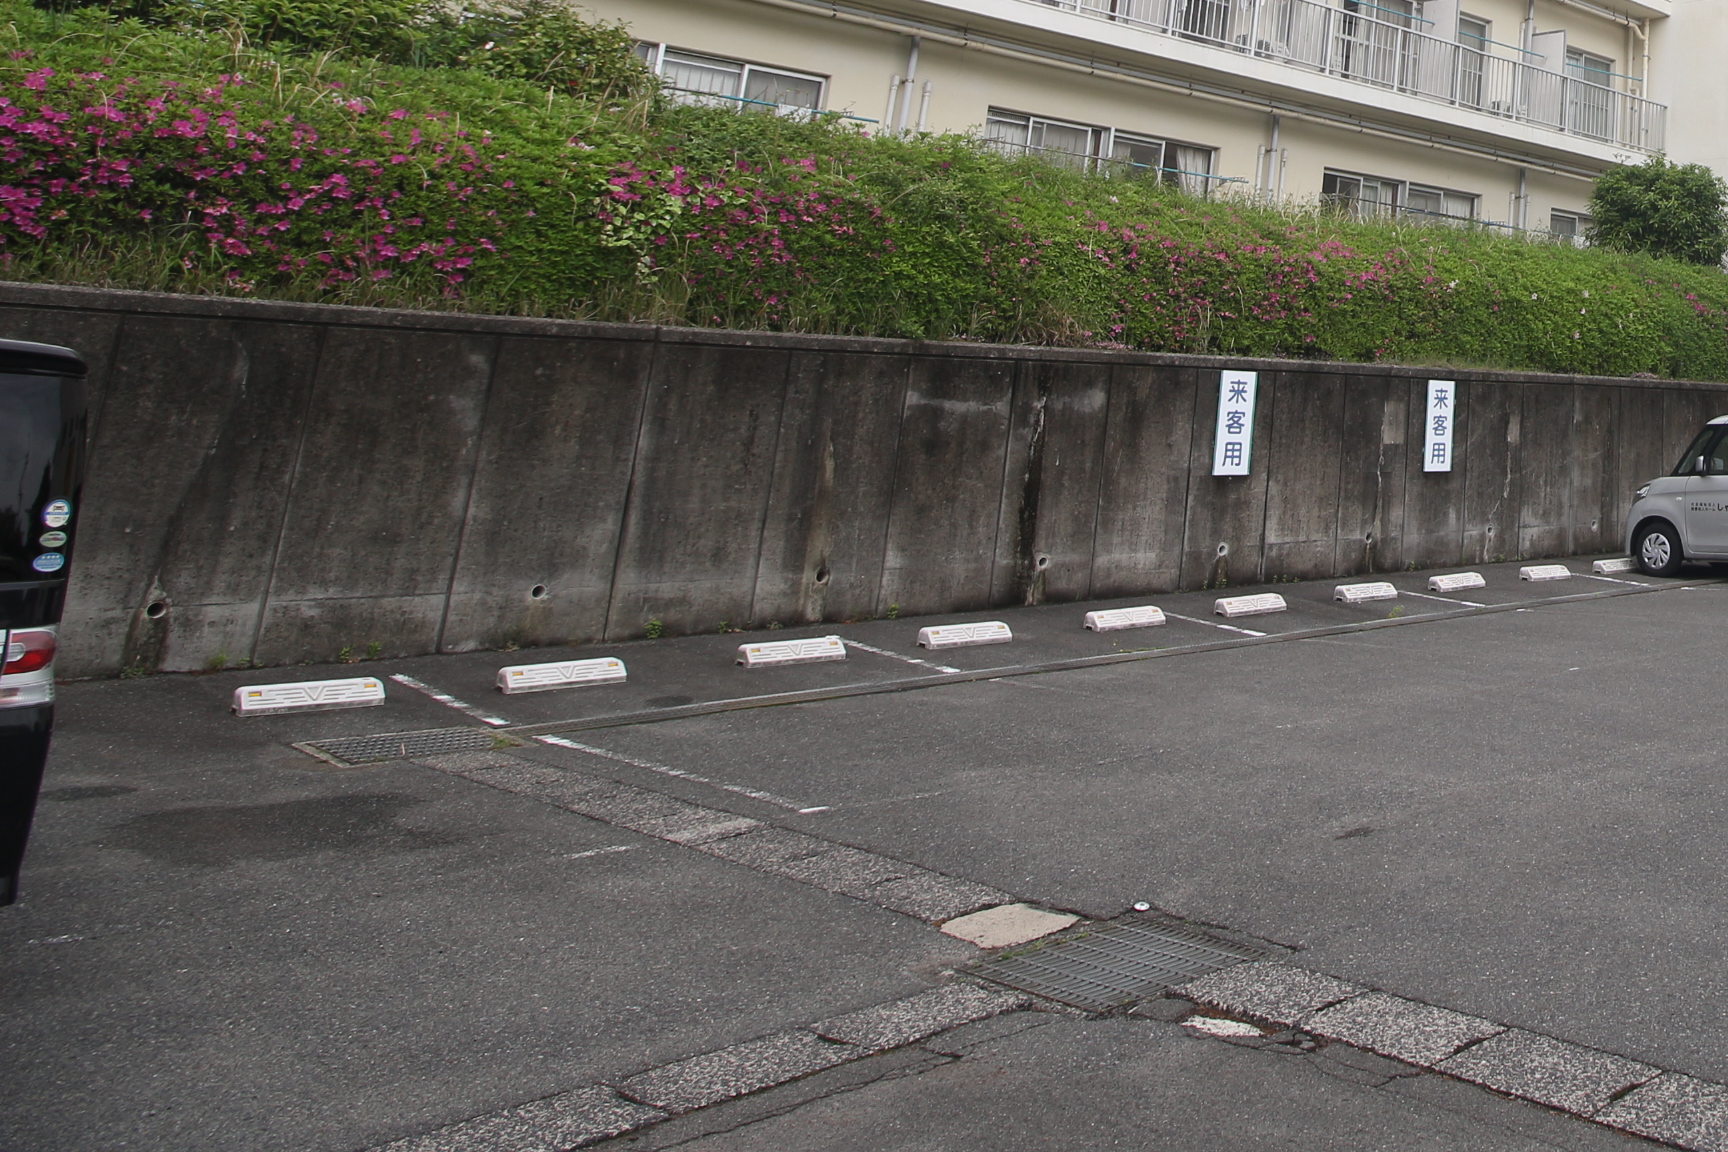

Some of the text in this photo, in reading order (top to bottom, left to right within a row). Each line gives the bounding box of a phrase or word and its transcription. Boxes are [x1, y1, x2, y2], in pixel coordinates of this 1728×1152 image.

[1222, 379, 1248, 467] 来客用
[1430, 388, 1448, 464] 来客用
